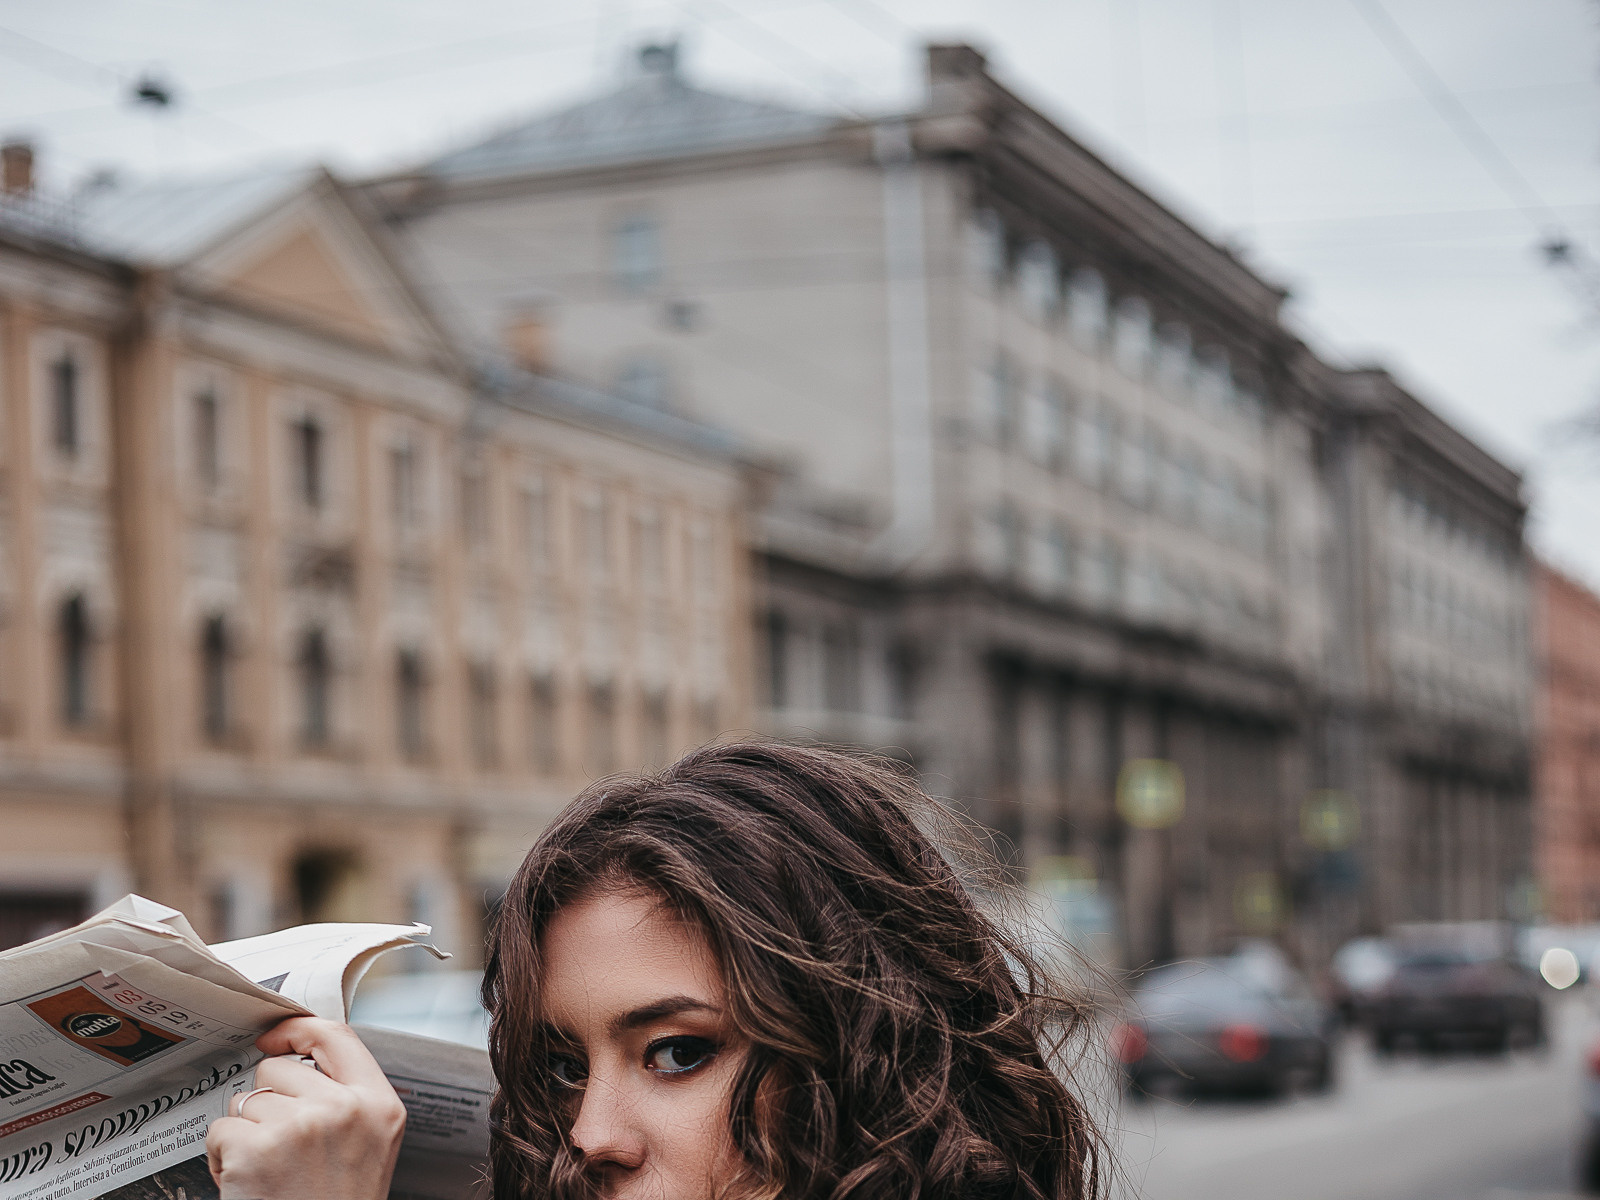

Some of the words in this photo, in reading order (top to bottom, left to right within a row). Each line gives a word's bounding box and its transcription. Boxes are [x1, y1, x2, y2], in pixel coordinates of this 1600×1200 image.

[114, 990, 142, 1004] 03
[137, 1001, 167, 1015] 05
[161, 1011, 189, 1025] 19
[76, 1016, 121, 1037] motta
[0, 1059, 56, 1099] ica
[82, 1154, 106, 1173] Salvini
[106, 1142, 139, 1164] spiazzato:
[139, 1136, 150, 1149] mi
[149, 1126, 176, 1143] devono
[176, 1113, 207, 1134] spiegare
[54, 1184, 72, 1200] tutto.
[73, 1171, 105, 1192] Intervista
[105, 1170, 110, 1178] a
[110, 1153, 146, 1176] Gentiloni:
[146, 1148, 160, 1161] con
[160, 1141, 176, 1155] loro
[177, 1131, 196, 1149] Italia
